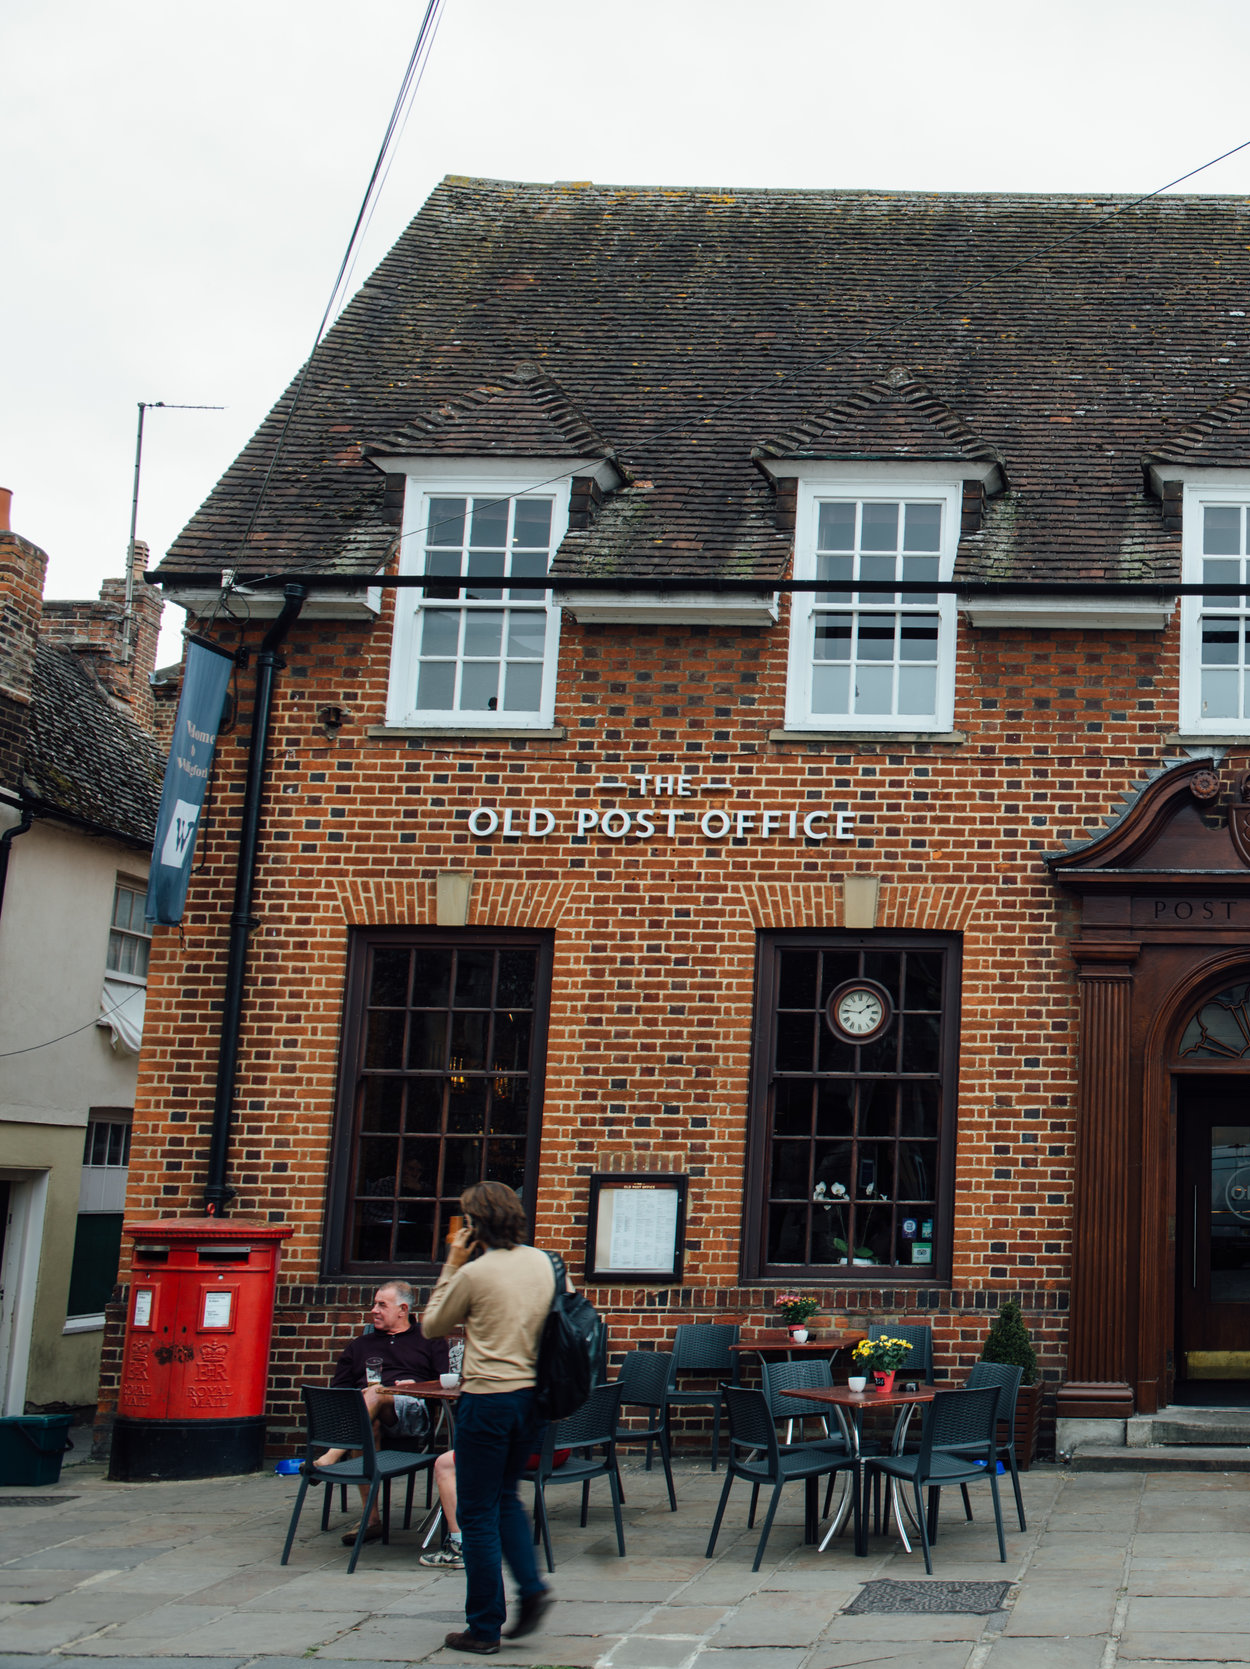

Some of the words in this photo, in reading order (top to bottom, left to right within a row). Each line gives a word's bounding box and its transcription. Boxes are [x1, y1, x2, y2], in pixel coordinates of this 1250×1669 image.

[635, 775, 692, 796] THE
[467, 807, 556, 837] OLD
[577, 808, 685, 839] POST
[701, 809, 856, 840] OFFICE
[176, 818, 196, 853] W
[1153, 900, 1238, 921] POST
[187, 1386, 234, 1397] ROYAL
[190, 1396, 230, 1408] MAIL
